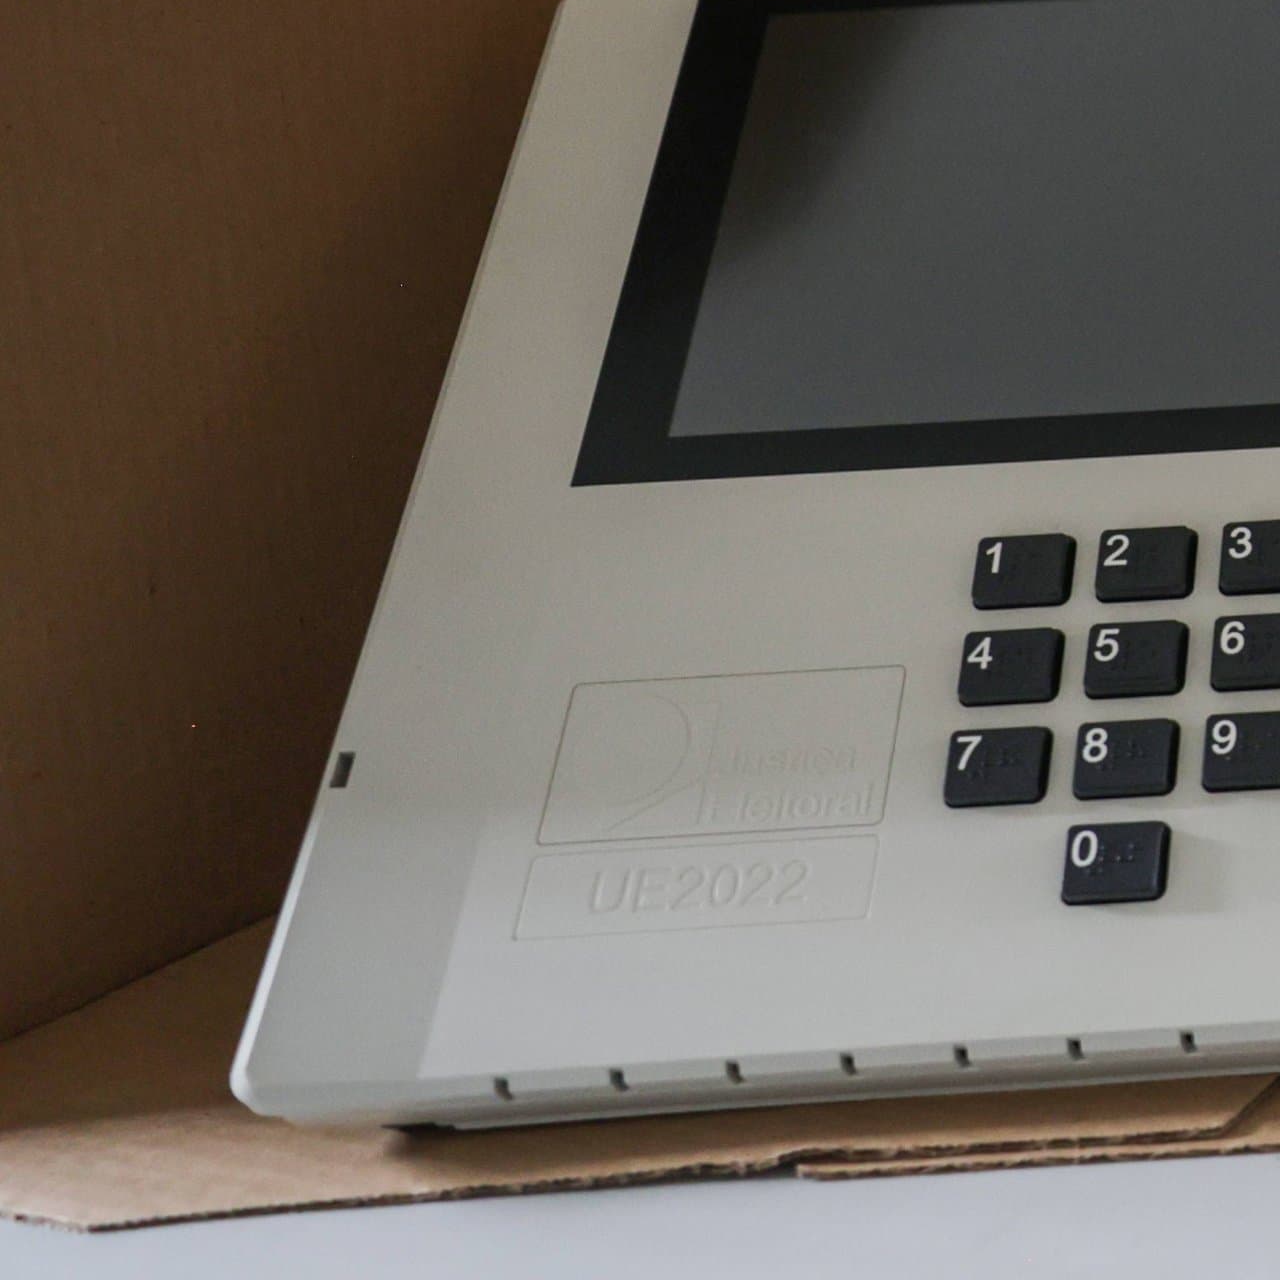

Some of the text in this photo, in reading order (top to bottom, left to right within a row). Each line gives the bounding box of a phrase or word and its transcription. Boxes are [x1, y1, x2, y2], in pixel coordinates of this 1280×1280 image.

[985, 542, 1003, 574] 1
[1103, 535, 1130, 566] 2
[1228, 527, 1253, 559] 3
[967, 637, 993, 670] 4
[1094, 629, 1120, 662] 5
[1220, 621, 1245, 655] 6
[957, 736, 982, 771] 7
[1082, 728, 1108, 763] 8
[1211, 720, 1237, 755] 9
[1071, 830, 1098, 868] 0
[587, 858, 812, 915] UE2022
